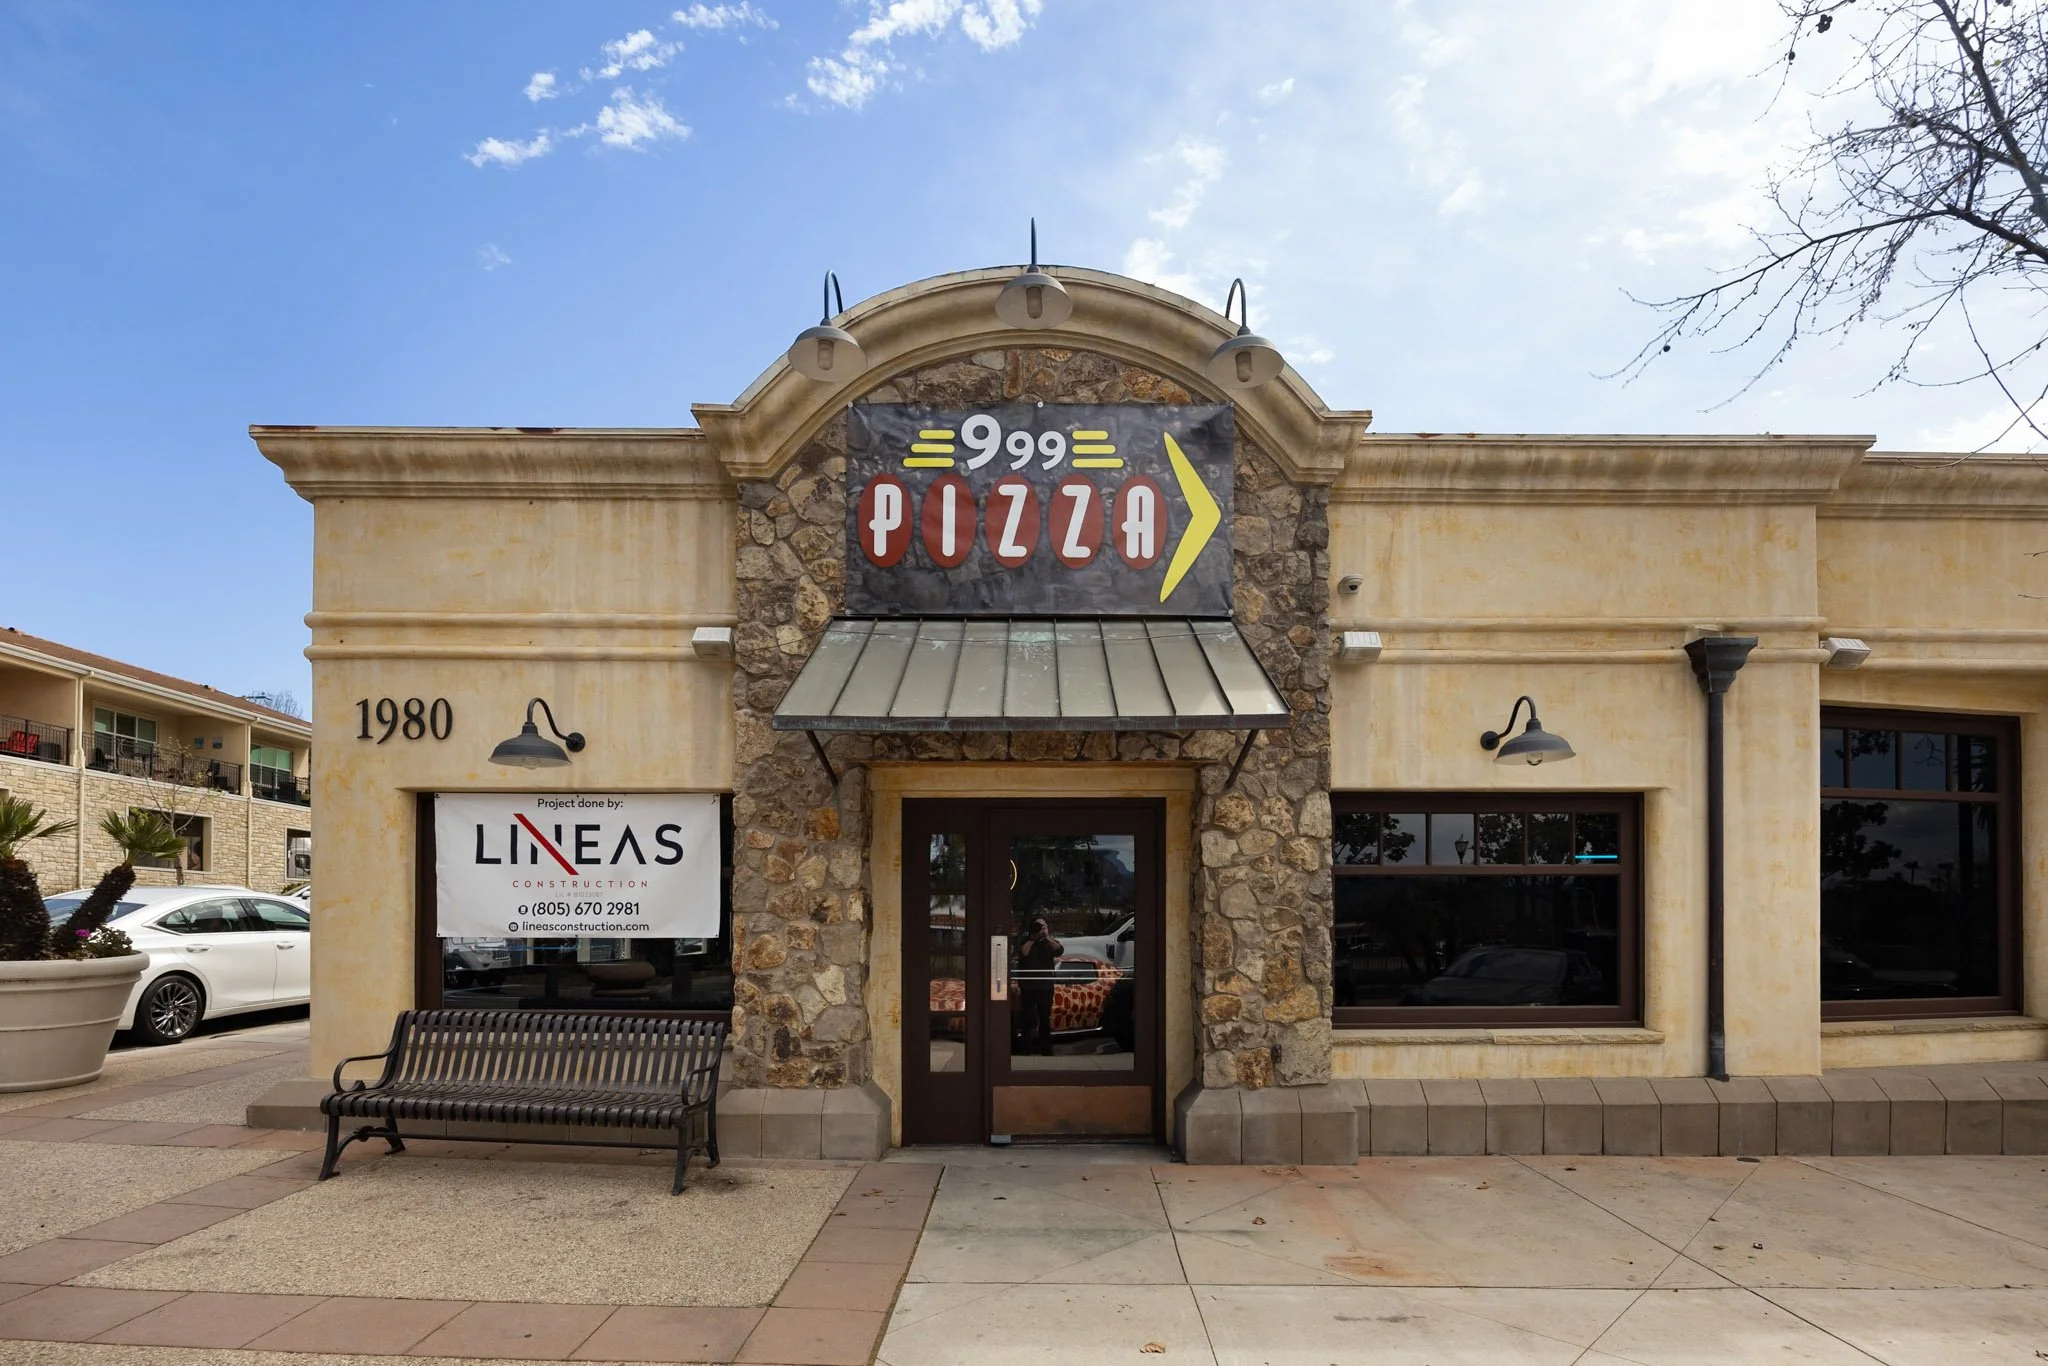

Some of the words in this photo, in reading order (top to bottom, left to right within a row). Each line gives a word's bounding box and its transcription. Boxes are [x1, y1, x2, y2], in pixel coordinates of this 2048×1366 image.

[960, 413, 1066, 471] 999
[869, 483, 1155, 559] PIZZA
[355, 697, 453, 745] 1980
[537, 798, 575, 810] Project
[577, 798, 605, 808] done
[607, 798, 624, 810] by:
[475, 813, 684, 875] LINEAS
[512, 880, 648, 888] CONSTRUCTION
[532, 902, 570, 917] (805)
[574, 902, 602, 916] 670
[606, 902, 640, 916] 2981
[522, 921, 650, 932] lineasconstruction.com
